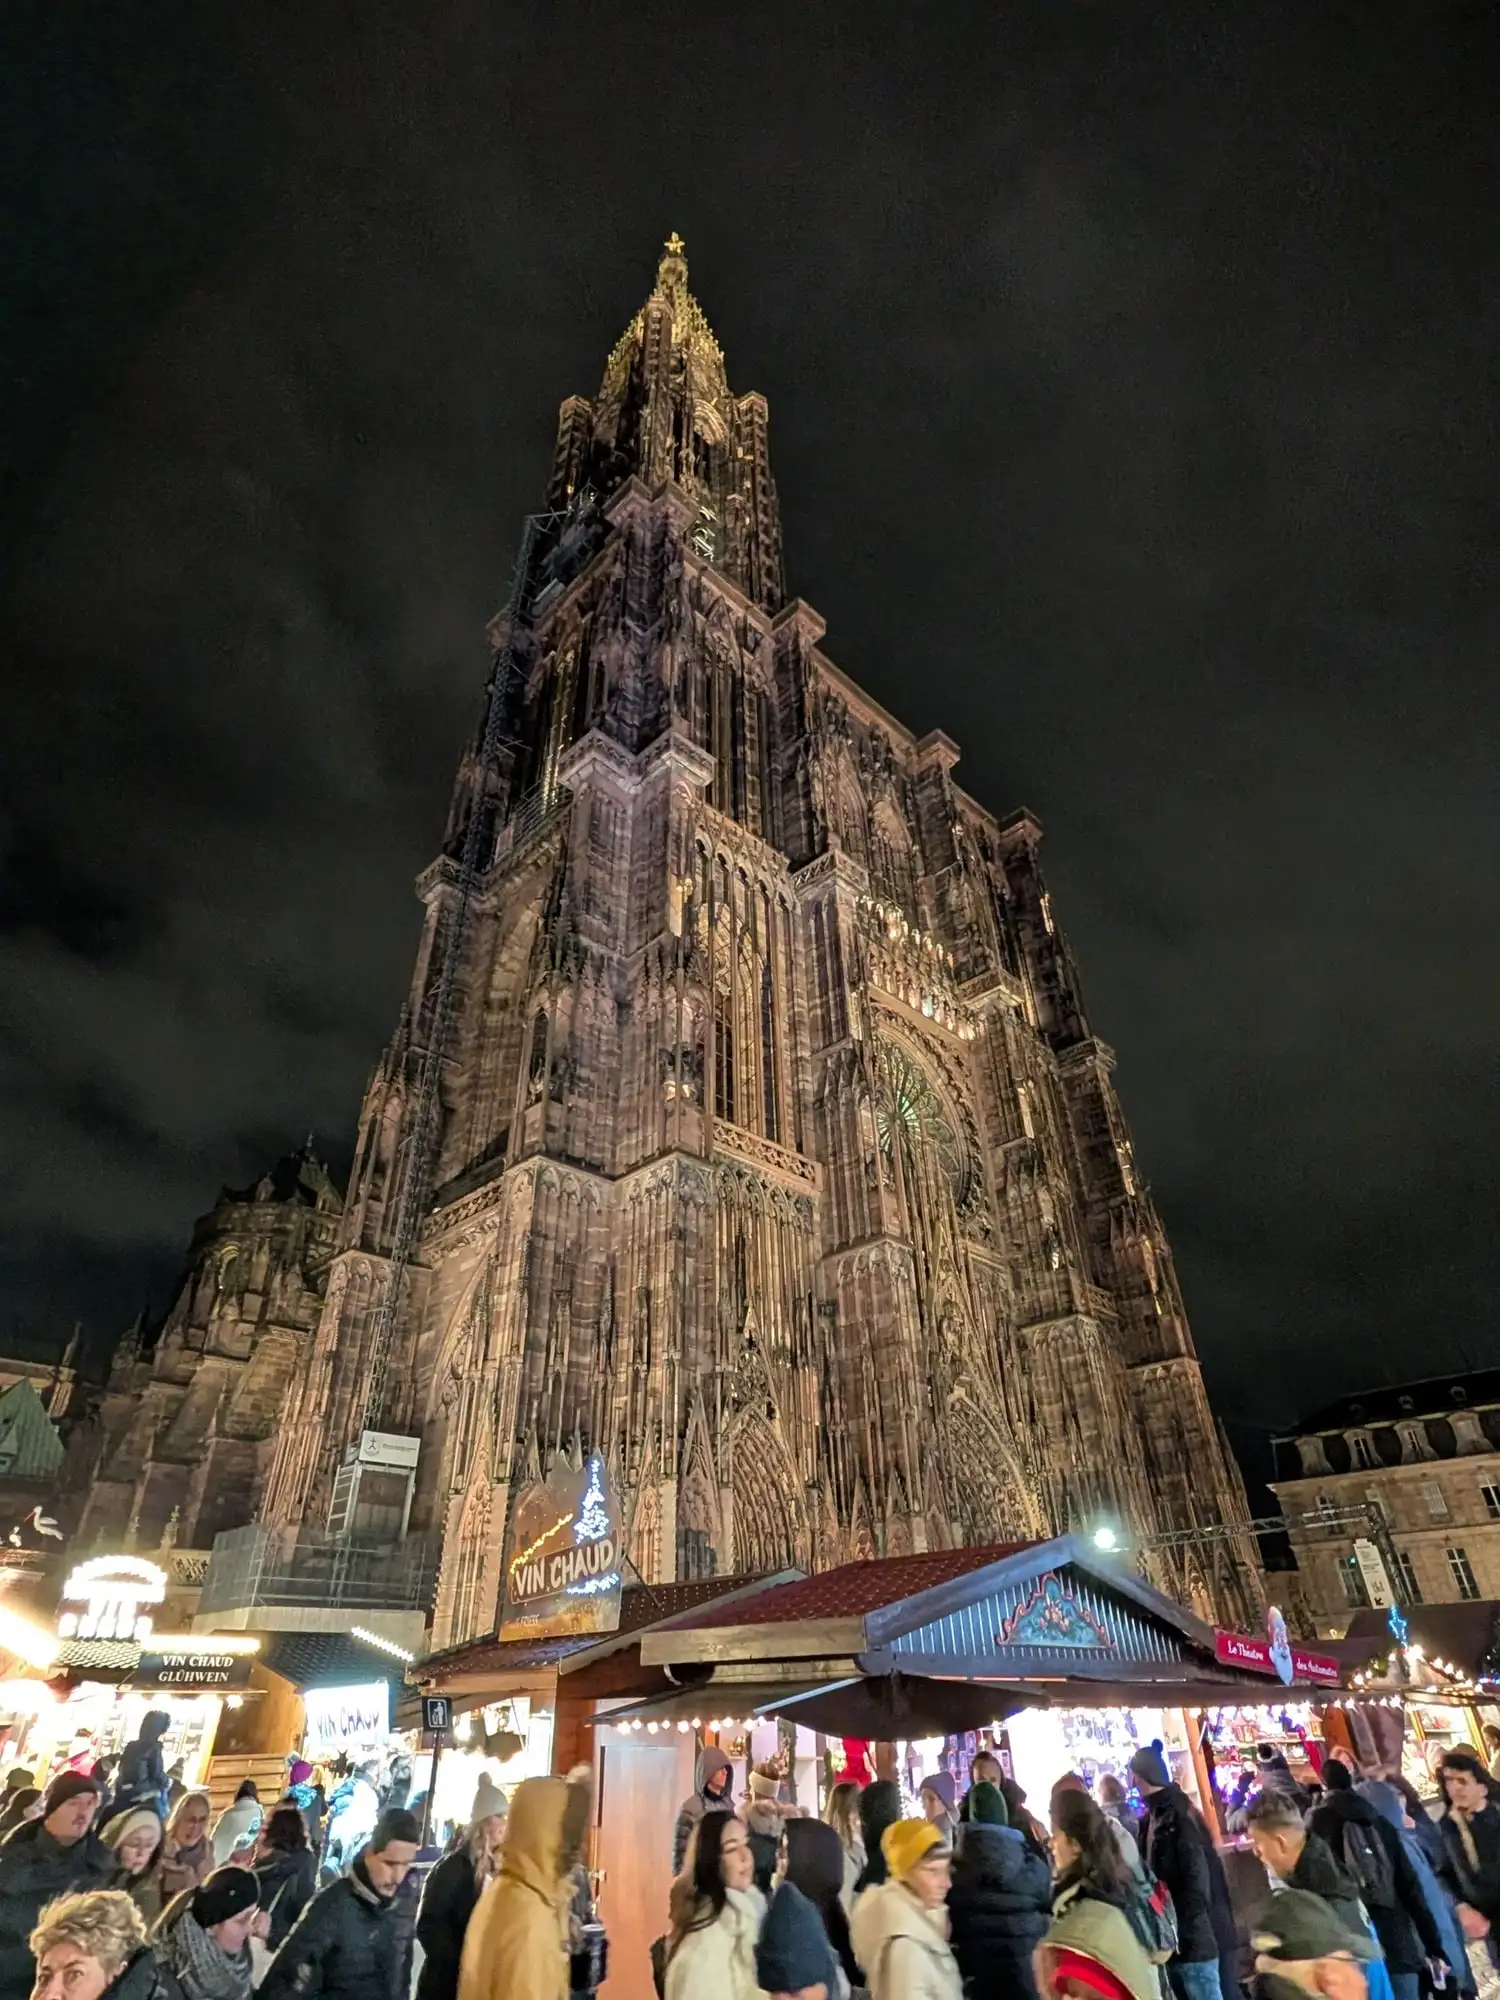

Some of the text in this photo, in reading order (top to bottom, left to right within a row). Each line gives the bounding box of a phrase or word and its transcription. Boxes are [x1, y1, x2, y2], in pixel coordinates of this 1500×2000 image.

[515, 1538, 614, 1597] VIN CHAUD
[1227, 1640, 1238, 1655] Le
[162, 1655, 234, 1668] VIN CHAUD
[158, 1669, 230, 1683] GLÜHWEIN
[316, 1713, 337, 1739] VIN
